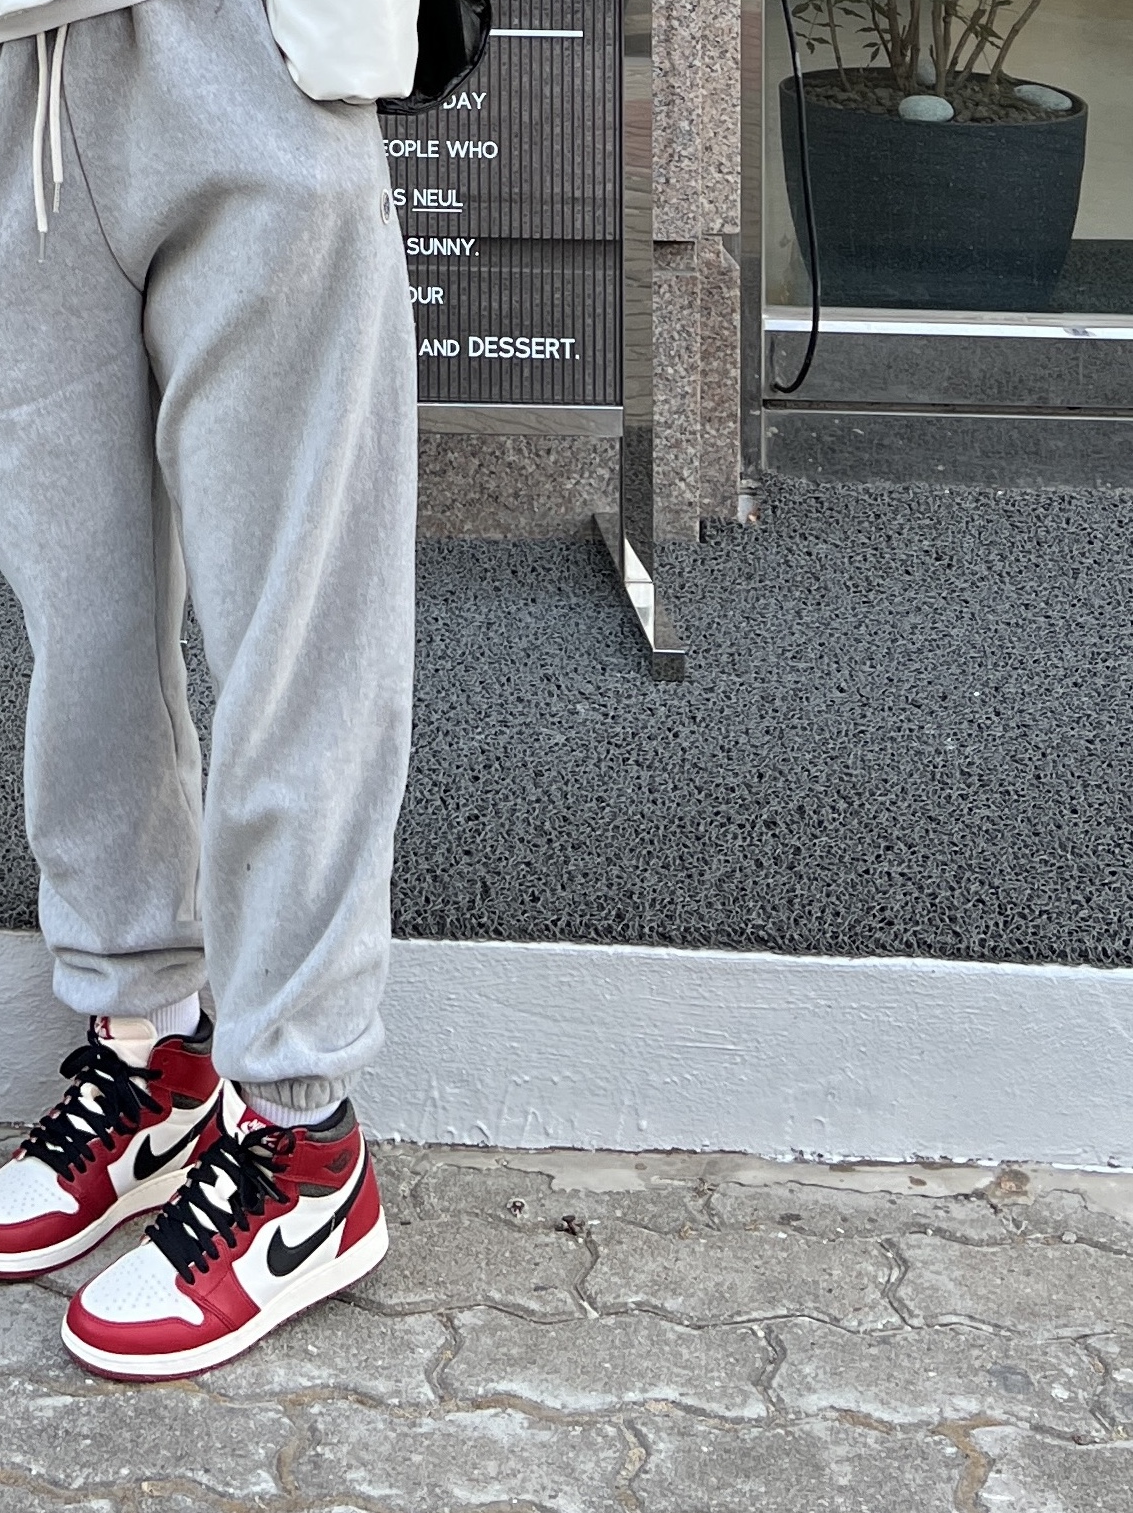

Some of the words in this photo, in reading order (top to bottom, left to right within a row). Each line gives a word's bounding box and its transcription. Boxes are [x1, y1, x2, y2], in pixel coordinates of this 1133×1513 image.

[446, 140, 499, 159] WHO
[413, 188, 464, 207] NEUL
[406, 237, 480, 257] SUNNY.
[418, 338, 461, 357] AND
[468, 336, 581, 361] DESSERT.
